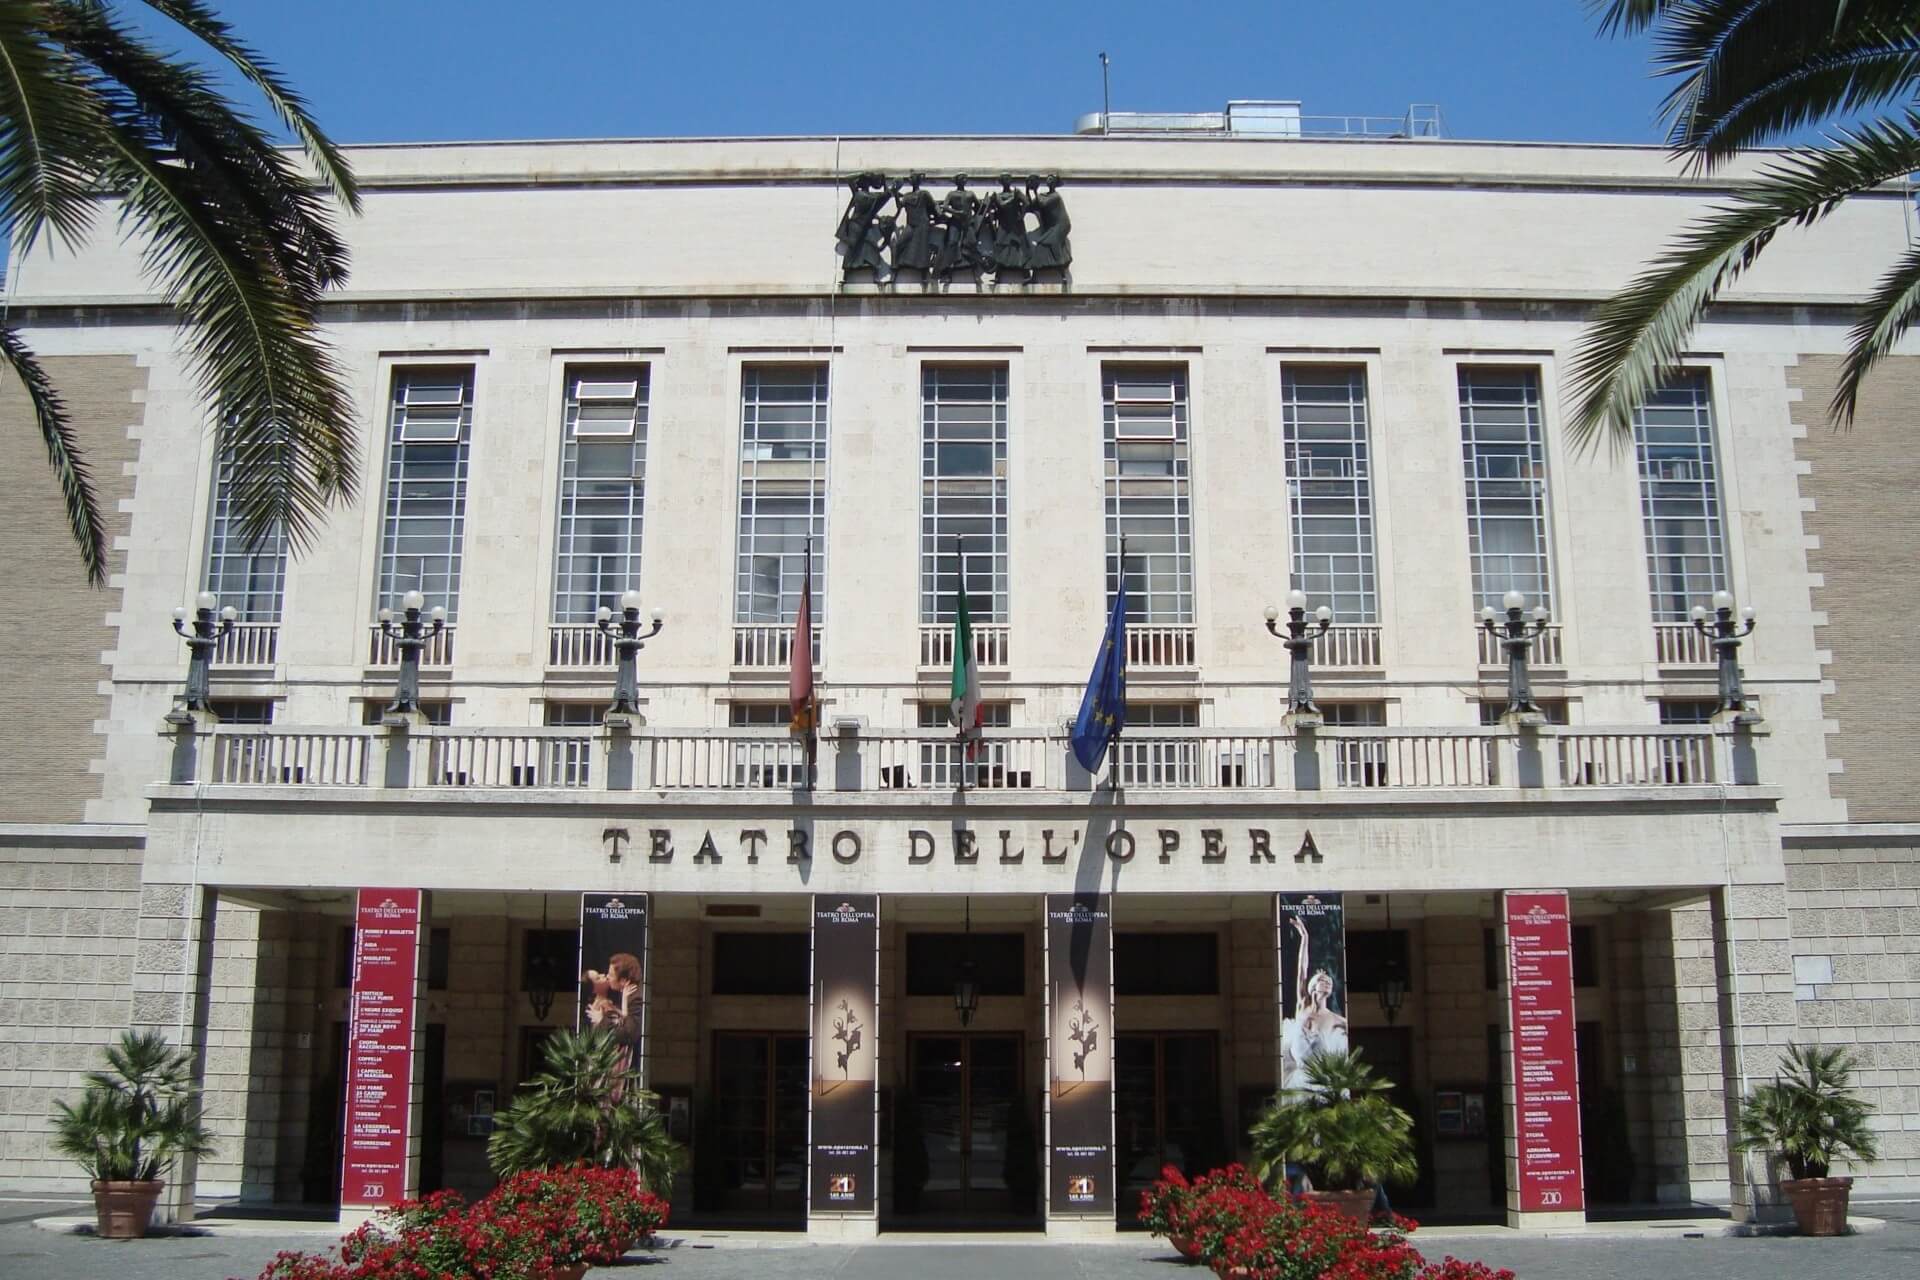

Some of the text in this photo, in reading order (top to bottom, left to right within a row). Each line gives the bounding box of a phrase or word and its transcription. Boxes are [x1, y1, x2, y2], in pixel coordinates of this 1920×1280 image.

[602, 829, 1323, 865] TEATRO DELL'OPERA
[362, 1184, 384, 1197] 2010
[1542, 1191, 1562, 1204] 2010
